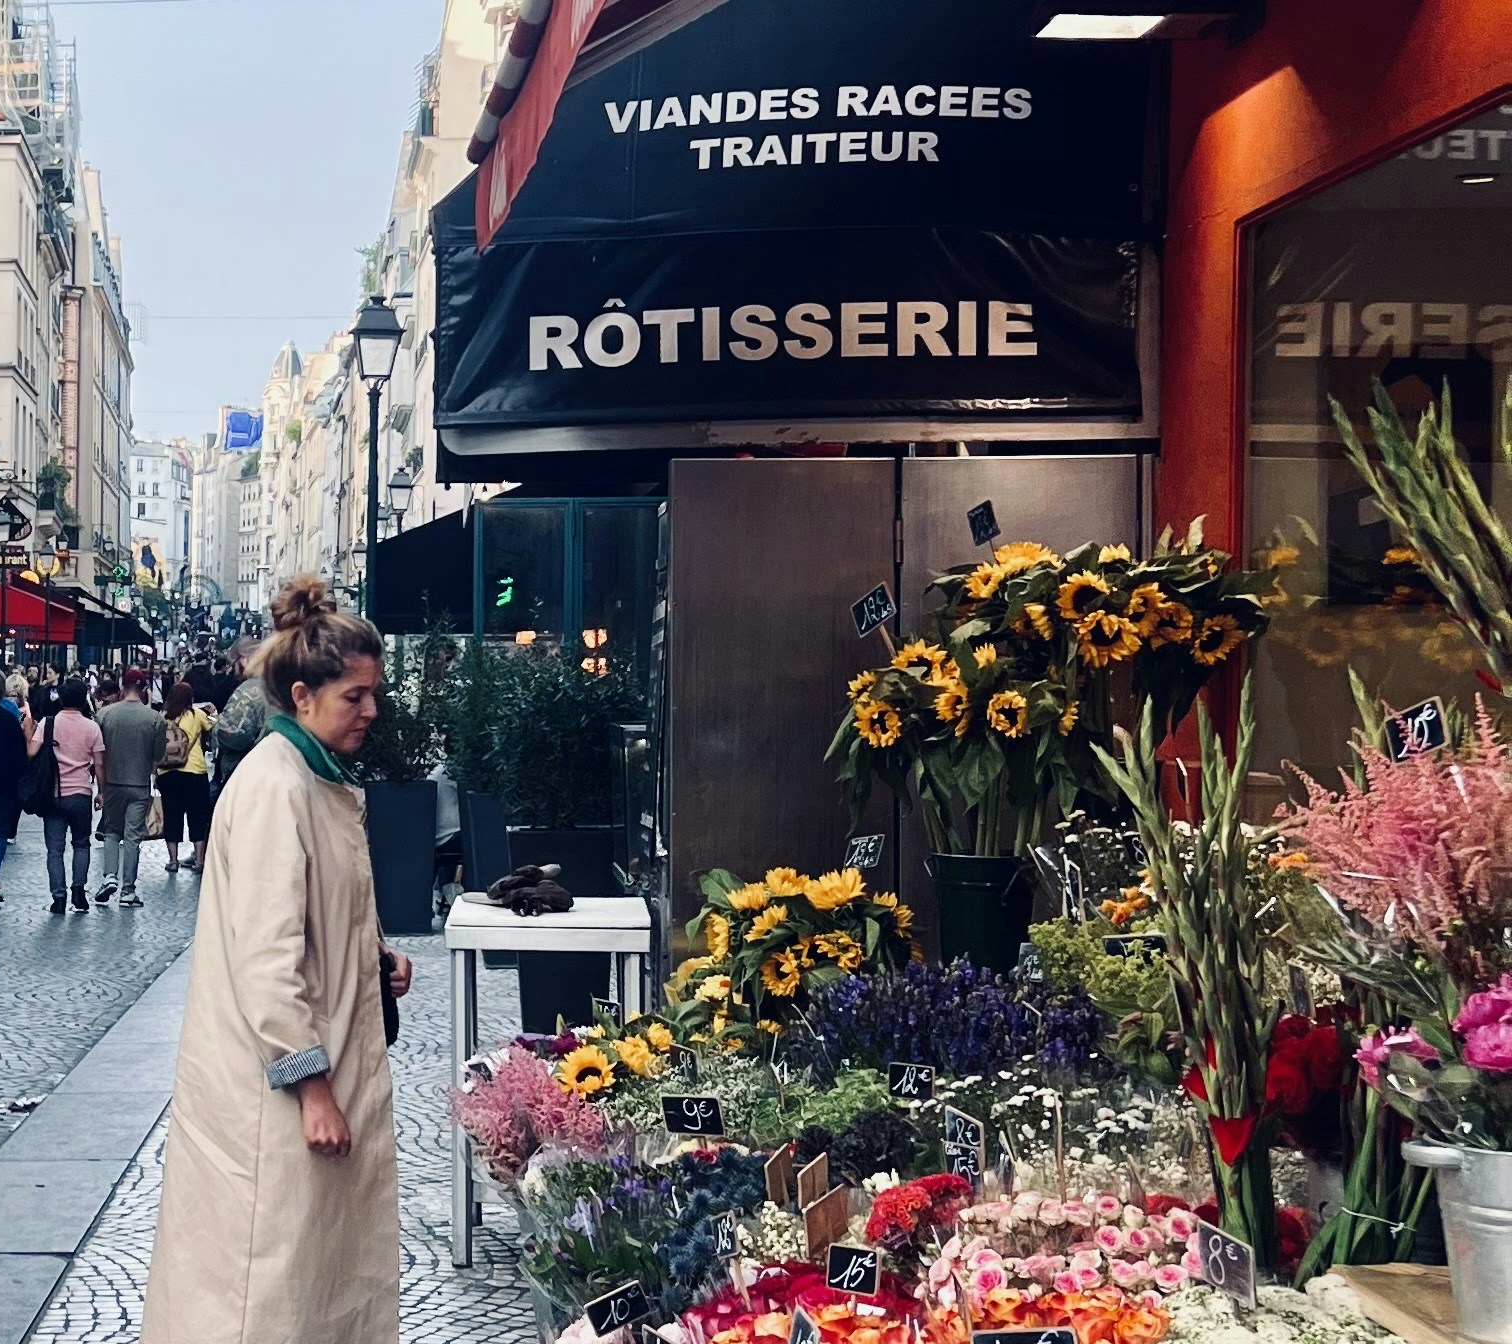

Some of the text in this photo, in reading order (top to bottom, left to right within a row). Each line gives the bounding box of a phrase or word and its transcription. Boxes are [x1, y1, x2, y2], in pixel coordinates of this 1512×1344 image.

[604, 84, 1033, 133] VIANDES RACEES
[690, 131, 940, 170] TRAITEUR
[529, 298, 1038, 371] RÔTISSERIE
[892, 1066, 931, 1094] 12€
[682, 1098, 714, 1131] 9€
[955, 1117, 981, 1145] 8€
[829, 1252, 877, 1289] 15€
[1208, 1234, 1239, 1286] 8€
